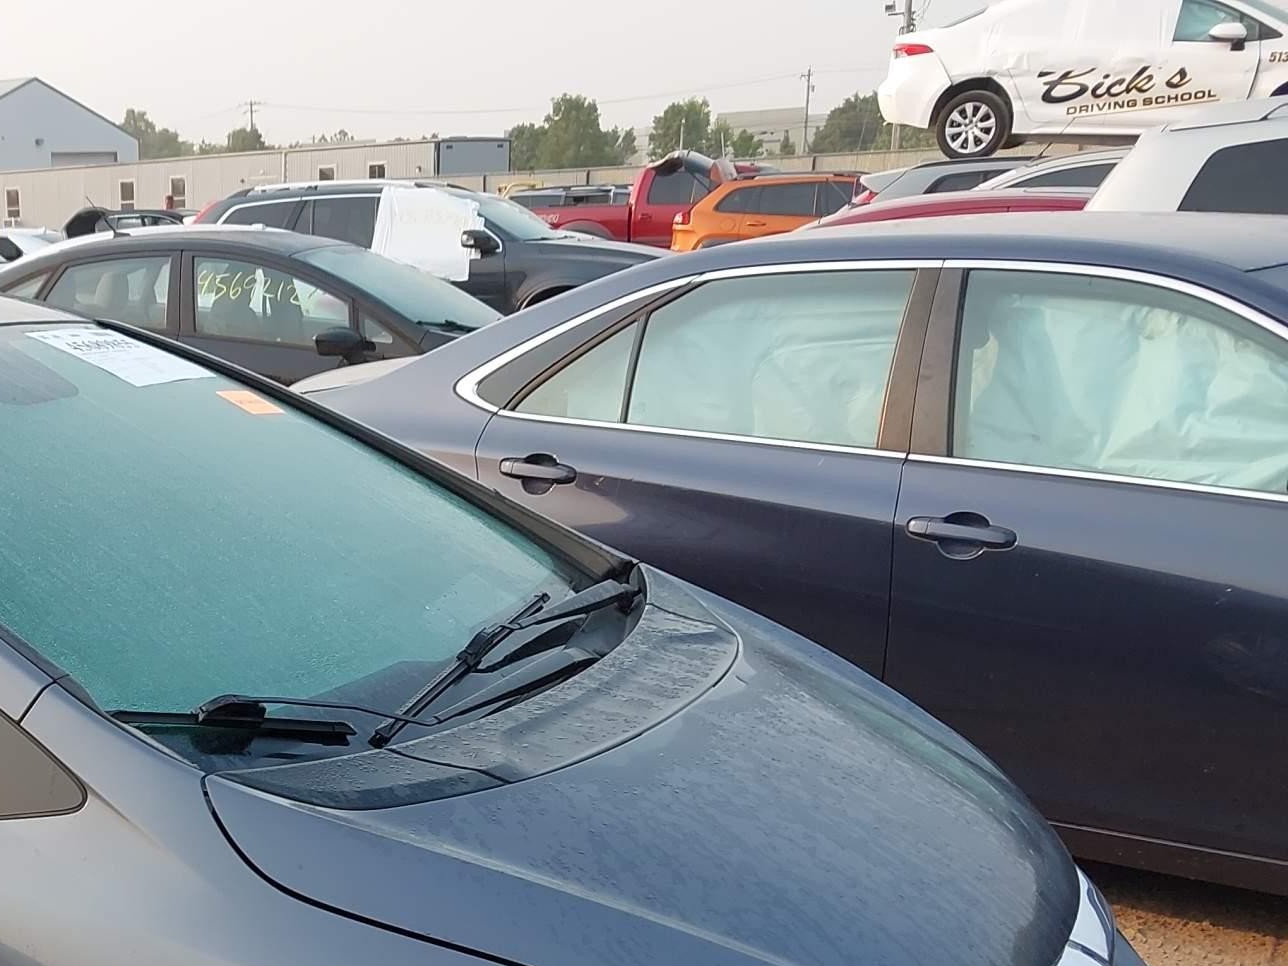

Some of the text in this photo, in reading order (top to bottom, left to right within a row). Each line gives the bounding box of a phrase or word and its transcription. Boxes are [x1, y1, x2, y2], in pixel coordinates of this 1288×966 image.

[1037, 65, 1193, 104] Bick's
[1065, 88, 1217, 116] DRIVING SCHOOL
